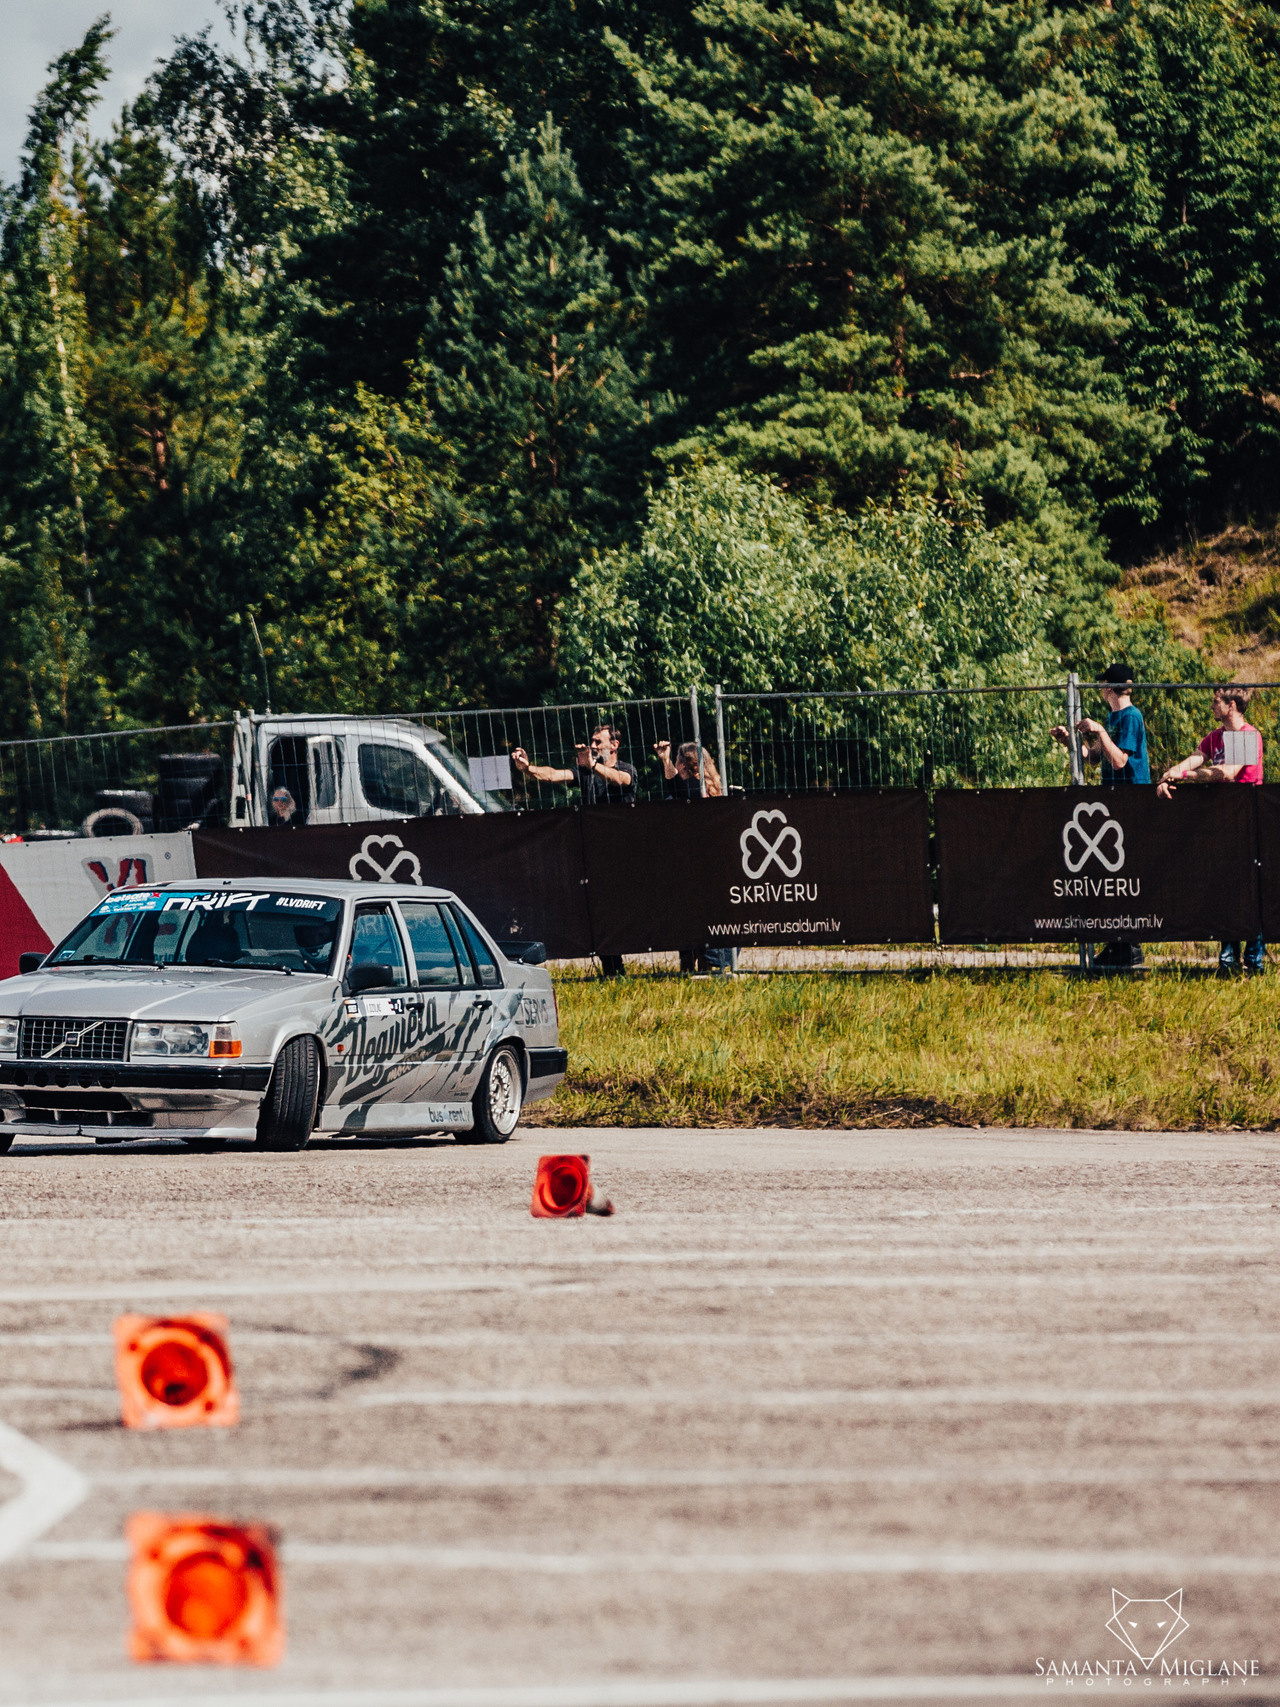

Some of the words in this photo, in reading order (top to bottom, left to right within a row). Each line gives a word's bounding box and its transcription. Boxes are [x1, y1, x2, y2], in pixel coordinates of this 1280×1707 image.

[729, 882, 818, 904] SKRĪVERU
[1053, 876, 1141, 897] SKRĪVERU
[163, 893, 270, 911] DRIFT
[276, 896, 327, 911] #LVDRIFT
